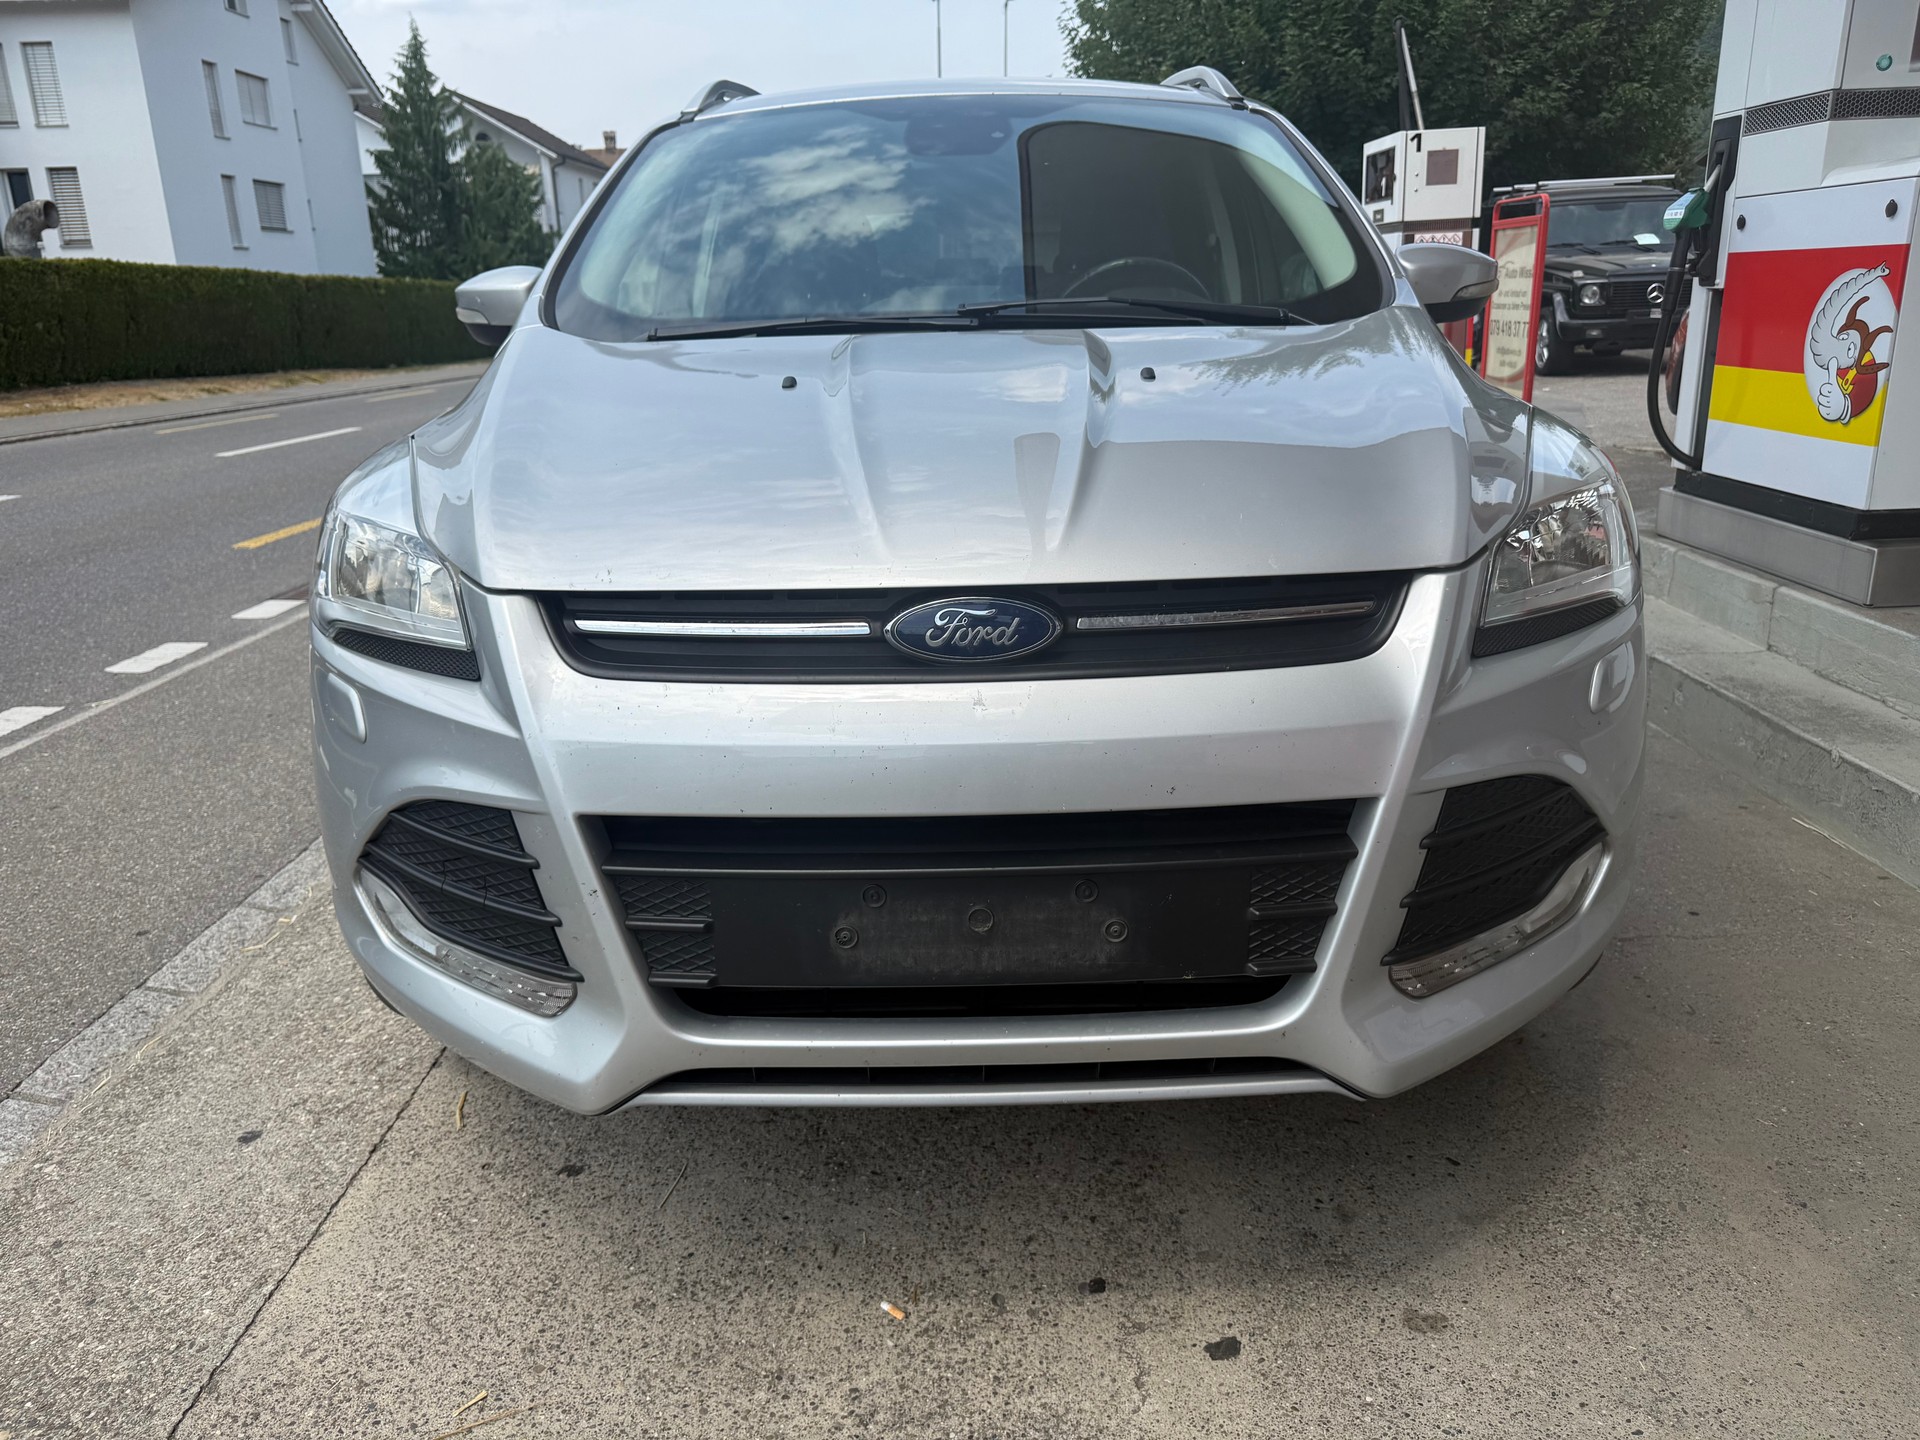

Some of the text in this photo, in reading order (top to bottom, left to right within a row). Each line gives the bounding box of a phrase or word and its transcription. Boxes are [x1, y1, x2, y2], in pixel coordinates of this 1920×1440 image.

[1410, 133, 1422, 152] 1
[1381, 176, 1386, 197] 1
[1490, 319, 1500, 336] 079
[1501, 320, 1511, 337] 418
[1513, 321, 1521, 337] 37
[925, 608, 1020, 648] Ford
